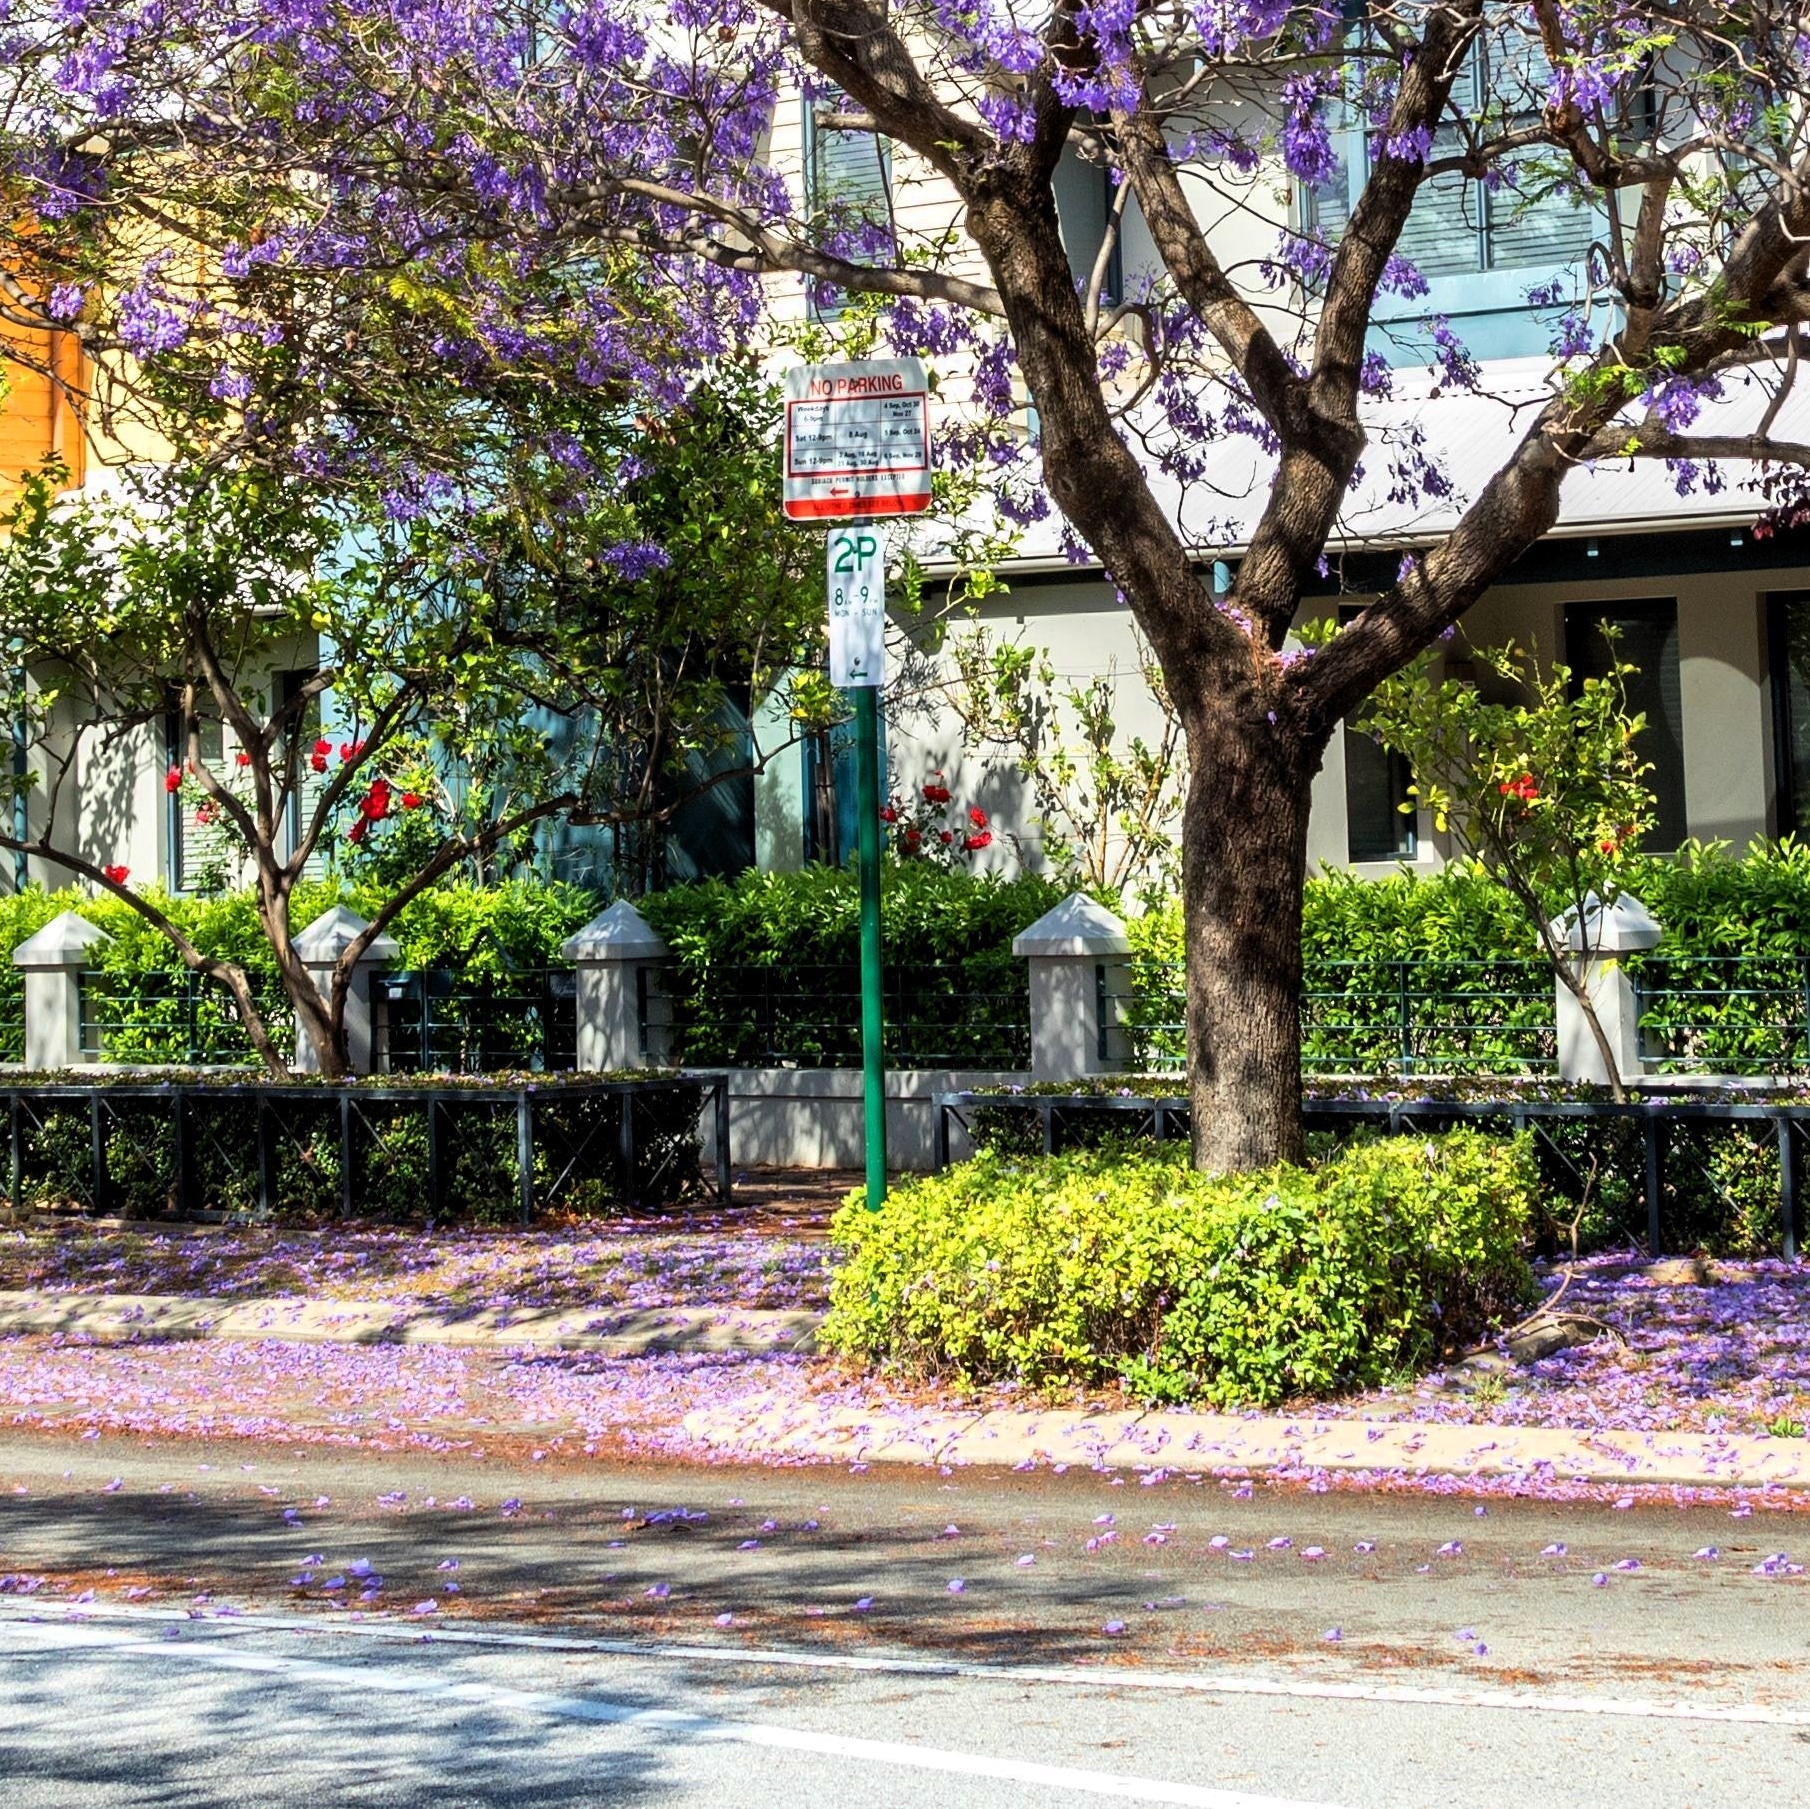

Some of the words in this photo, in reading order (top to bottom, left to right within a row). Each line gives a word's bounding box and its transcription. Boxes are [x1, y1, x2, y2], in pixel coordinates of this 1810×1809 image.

[810, 379, 833, 396] NO
[837, 374, 903, 394] PARKING
[795, 434, 806, 442] Sat
[854, 431, 868, 439] Aug
[868, 459, 879, 467] Aug
[834, 536, 877, 573] 2P
[862, 608, 878, 617] SUN
